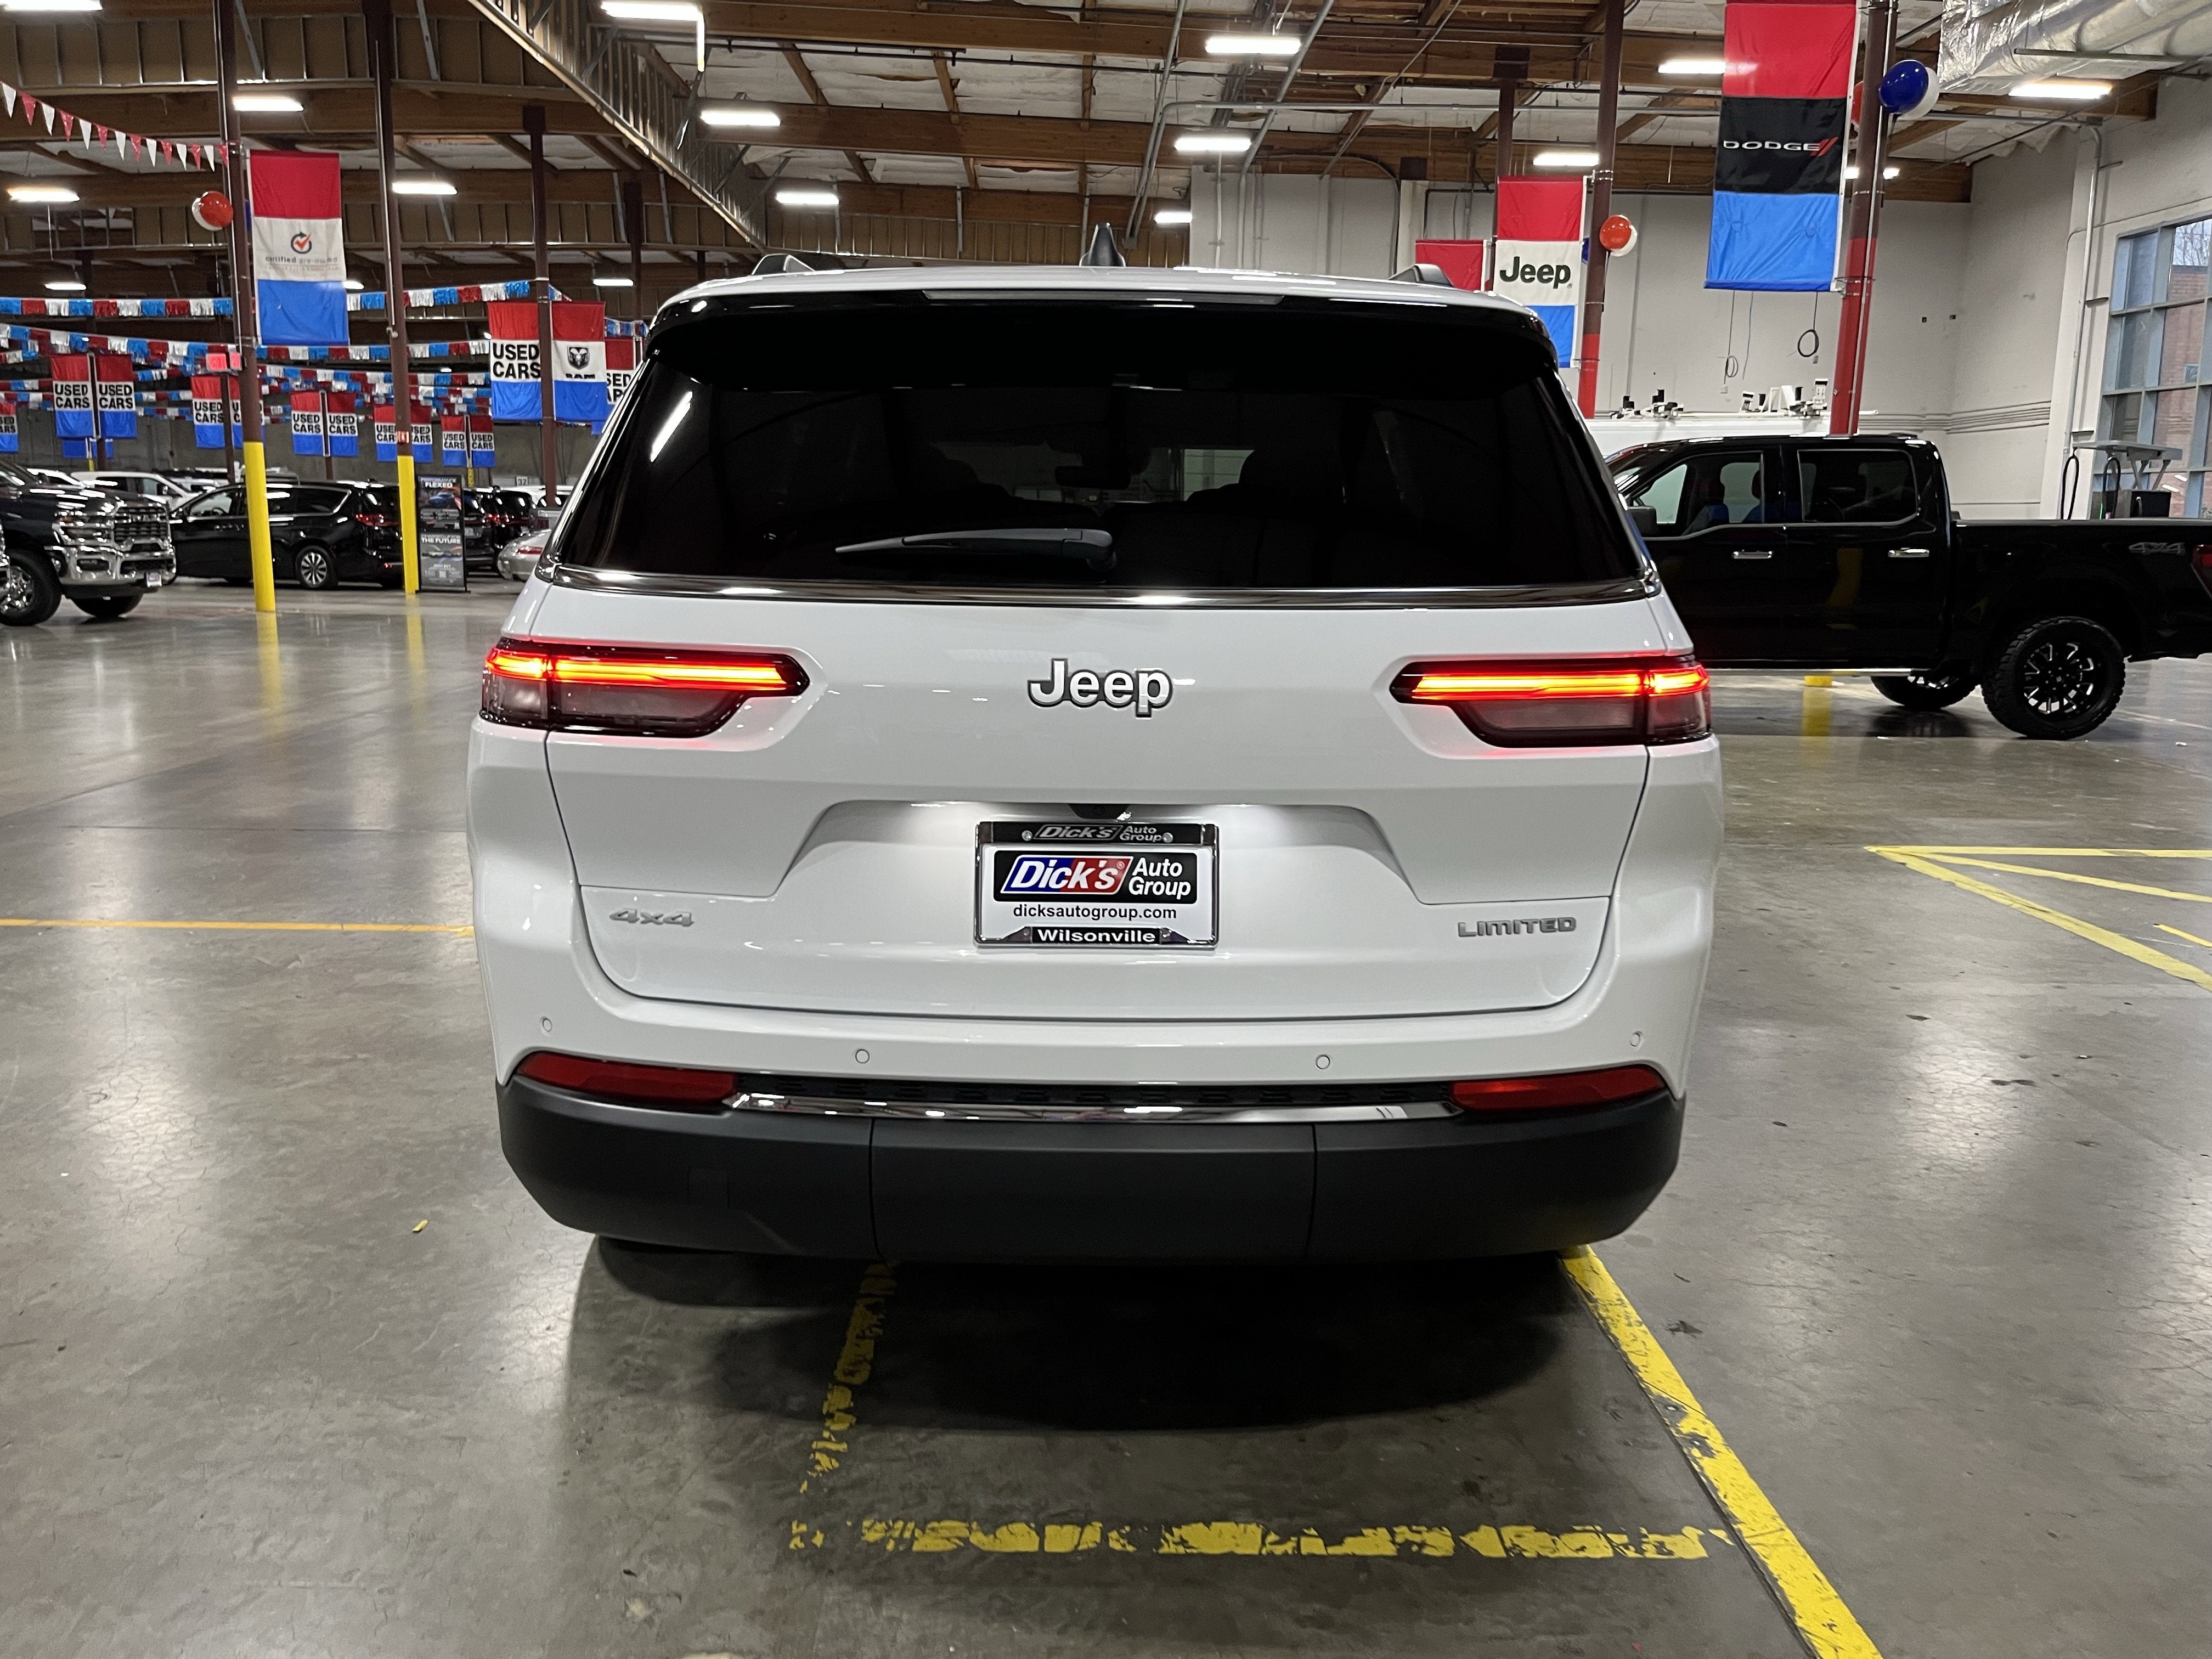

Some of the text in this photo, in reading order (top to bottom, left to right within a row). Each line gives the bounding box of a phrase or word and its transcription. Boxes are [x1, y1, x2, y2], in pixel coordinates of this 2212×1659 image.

[1723, 140, 1820, 151] DODGE
[1499, 256, 1571, 289] Jeep
[493, 342, 539, 360] USED
[493, 362, 540, 379] CARS
[606, 373, 631, 387] SED
[55, 384, 88, 396] USED
[99, 384, 132, 396] USED
[55, 397, 89, 408] CARS
[99, 397, 133, 409] CARS
[194, 402, 222, 411] USED
[195, 413, 223, 423] CARS
[293, 414, 320, 424] USED
[329, 415, 355, 424] USED
[294, 424, 321, 433] CARS
[329, 425, 356, 435] CARS
[376, 425, 396, 433] USE
[377, 433, 395, 442] CAR
[414, 435, 431, 443] ARS
[444, 441, 465, 449] CARS
[1028, 658, 1173, 718] Jeep
[1039, 825, 1156, 838] Dick's Auto
[1119, 833, 1163, 843] Group
[1010, 857, 1183, 889] Dick's Auto
[1128, 877, 1190, 900] Group
[1013, 904, 1177, 920] dicksautogroup.com
[1458, 917, 1576, 938] LIMITED
[1037, 929, 1156, 943] Wilsonville
